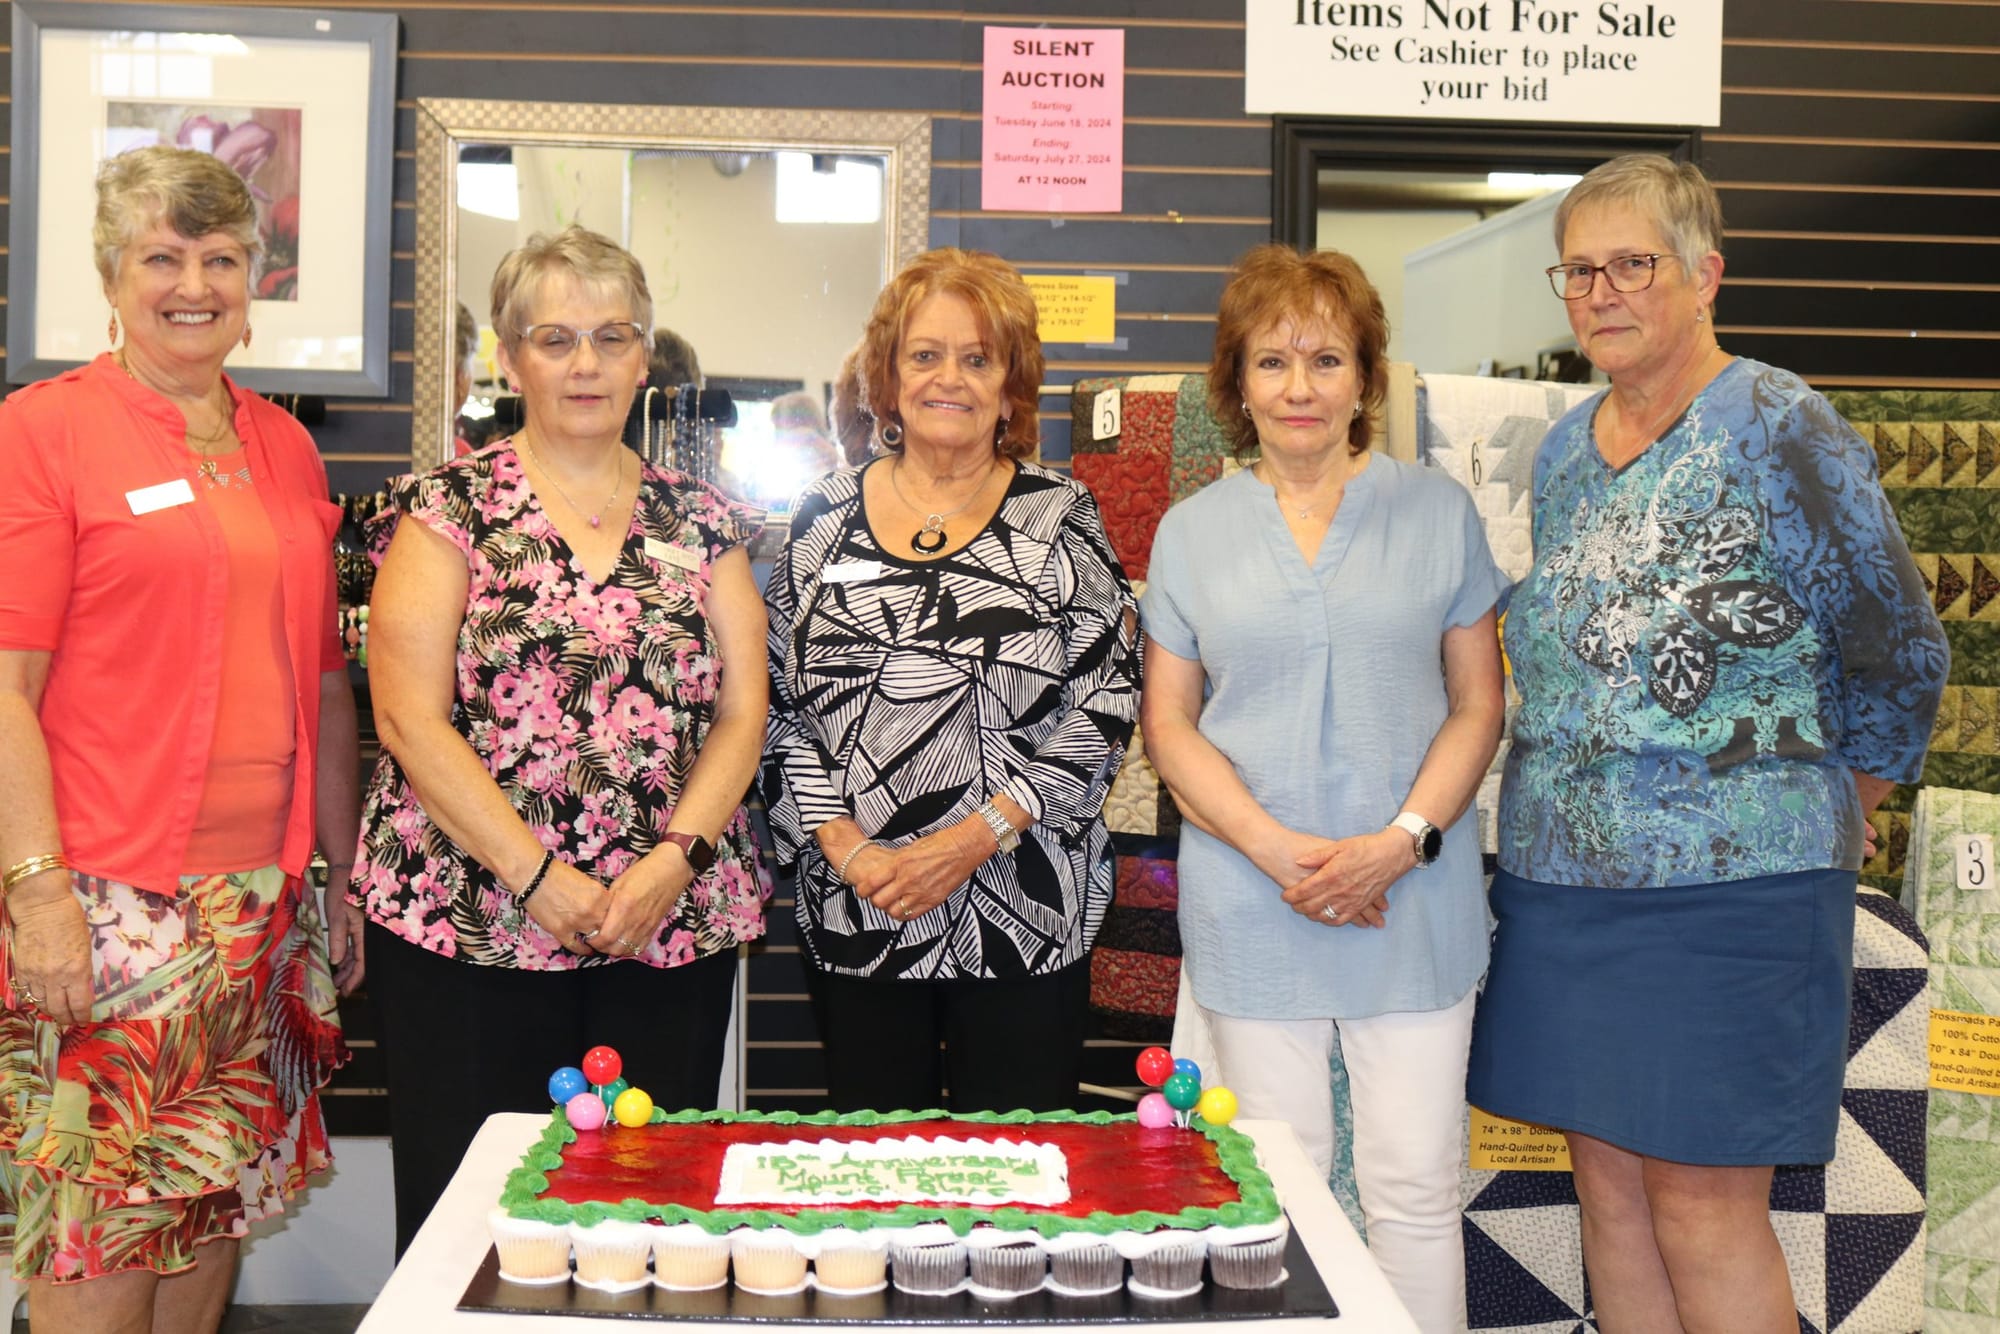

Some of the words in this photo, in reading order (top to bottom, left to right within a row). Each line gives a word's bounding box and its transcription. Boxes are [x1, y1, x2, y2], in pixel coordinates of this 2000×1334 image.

[1293, 0, 1403, 29] Items
[1422, 0, 1492, 33] Not
[1510, 0, 1579, 34] For
[1597, 2, 1677, 38] Sale
[1013, 40, 1094, 56] SILENT
[1331, 36, 1380, 62] See
[1394, 37, 1508, 67] Cashier
[1522, 45, 1549, 69] to
[1563, 45, 1638, 76] place
[1001, 72, 1105, 88] AUCTION
[1420, 78, 1489, 104] your
[1503, 77, 1548, 102] bid
[994, 116, 1037, 128] Tuesday
[1041, 119, 1066, 128] June
[1088, 119, 1112, 128] 2024
[994, 153, 1040, 164] Saturday
[1043, 154, 1065, 165] July
[1087, 155, 1111, 164] 2024
[1017, 176, 1031, 184] AT
[1037, 176, 1048, 184] 12
[1053, 176, 1087, 185] NOON
[1103, 397, 1115, 435] 5
[1472, 442, 1482, 486] 6
[1968, 839, 1985, 885] 3
[1943, 1029, 1968, 1040] 100%
[1959, 1048, 1976, 1057] 84"
[1936, 1073, 1964, 1084] Local
[1482, 1125, 1498, 1134] 74"
[1510, 1127, 1526, 1135] 98"
[1480, 1143, 1544, 1152] Hand-Quilted
[1547, 1144, 1558, 1153] by
[1490, 1155, 1517, 1163] Local
[1520, 1155, 1555, 1164] Artisan
[777, 1168, 880, 1187] Mount
